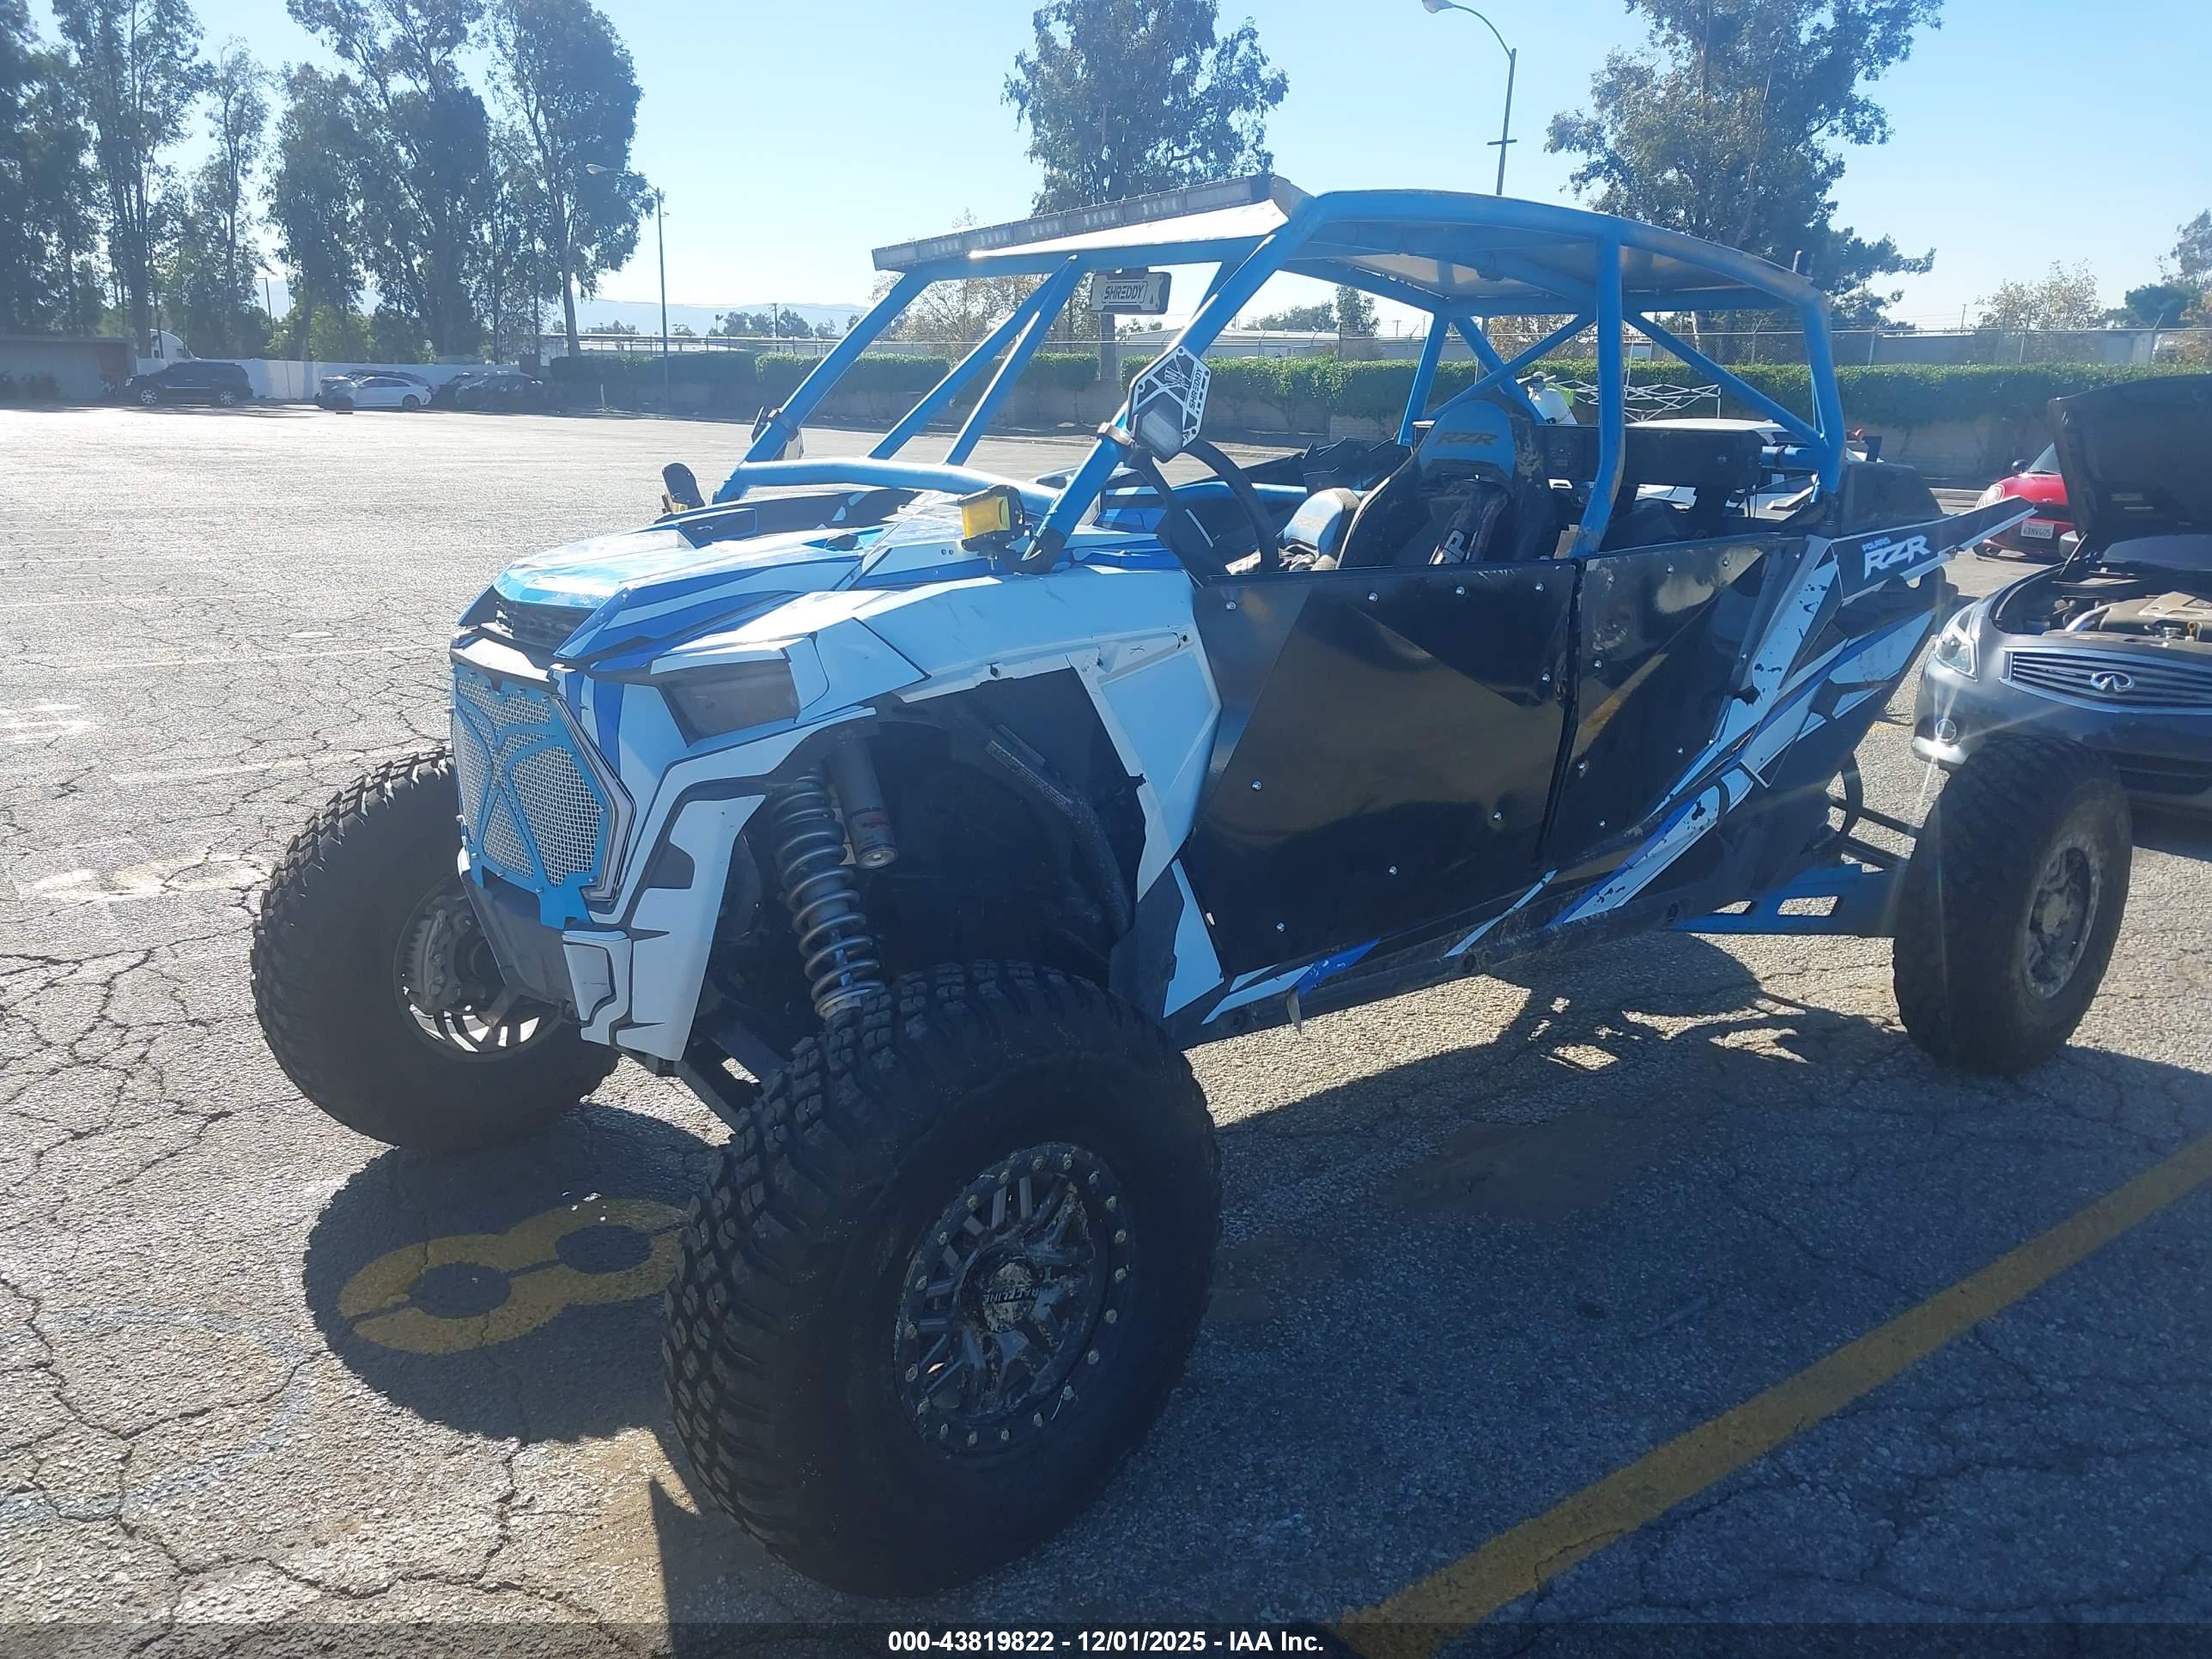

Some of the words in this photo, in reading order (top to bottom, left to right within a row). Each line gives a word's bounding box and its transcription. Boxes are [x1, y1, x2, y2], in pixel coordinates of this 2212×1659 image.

[1103, 285, 1145, 300] SHREDDY
[1188, 364, 1203, 410] SHREDDY
[1436, 432, 1498, 446] RZR
[1862, 537, 1891, 551] POLARIS
[1864, 535, 1930, 580] RZR
